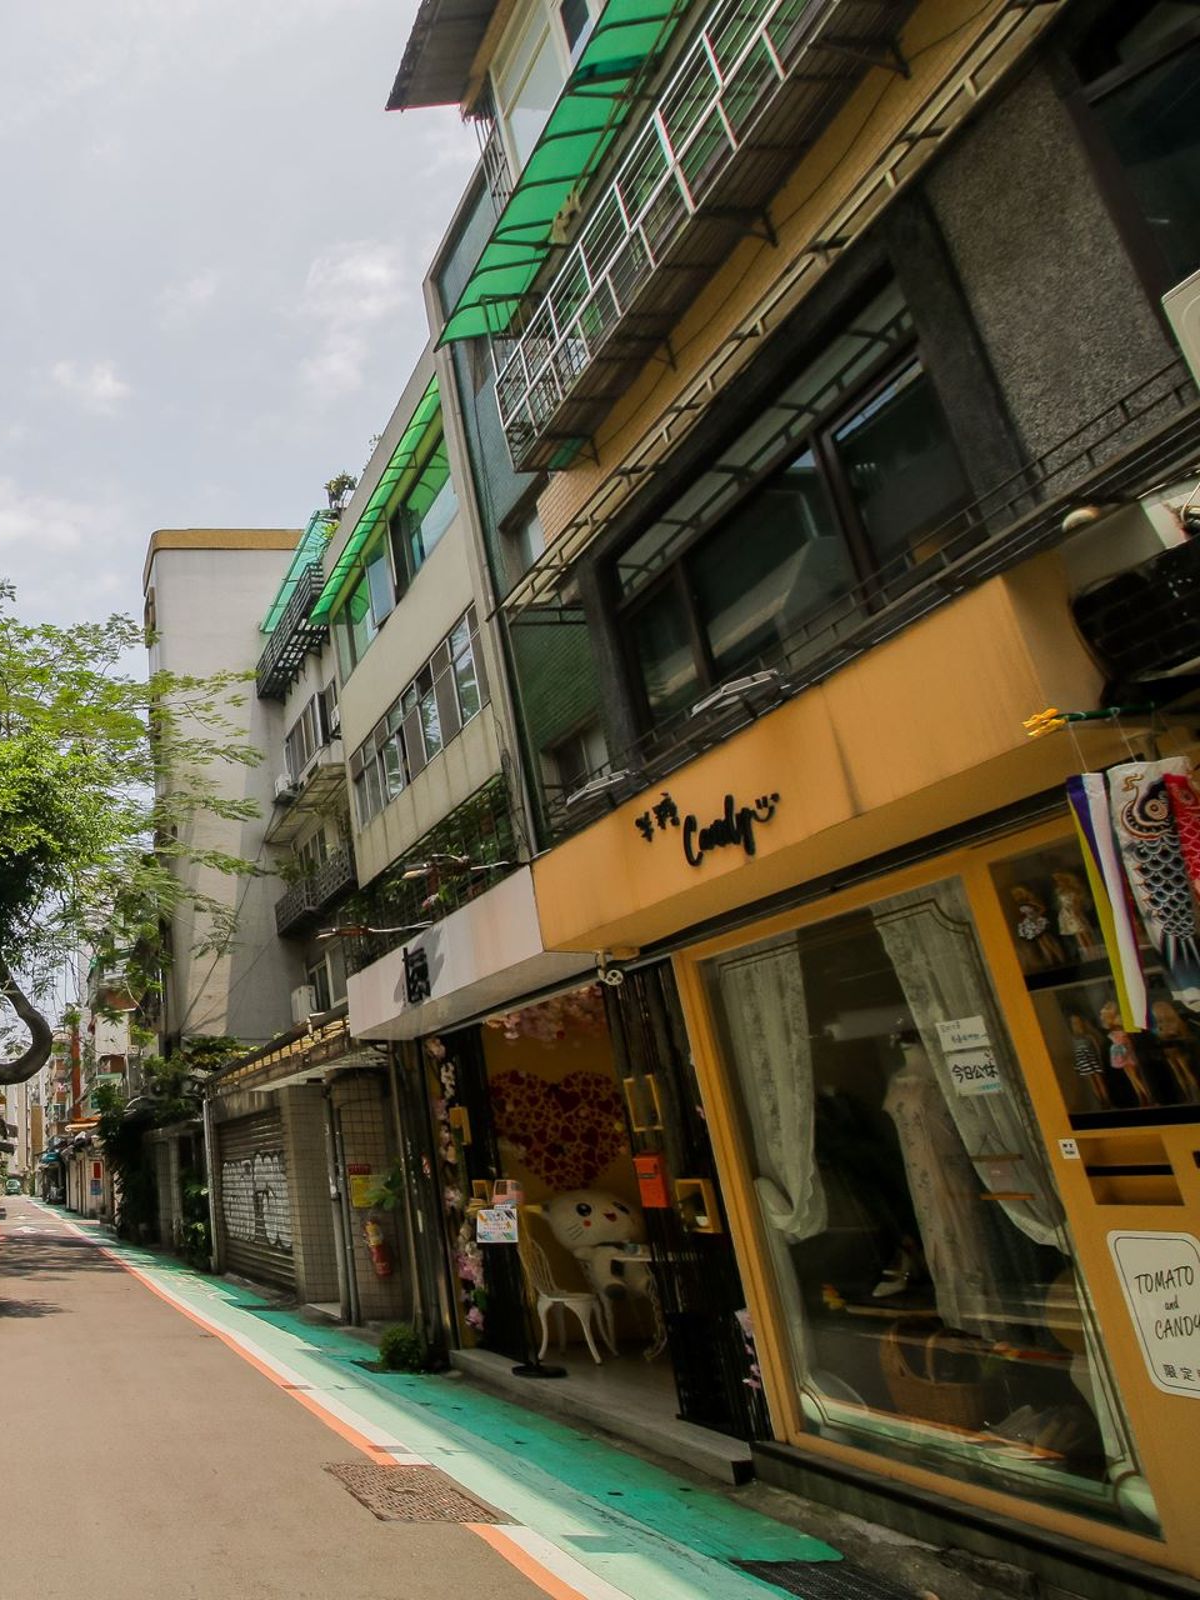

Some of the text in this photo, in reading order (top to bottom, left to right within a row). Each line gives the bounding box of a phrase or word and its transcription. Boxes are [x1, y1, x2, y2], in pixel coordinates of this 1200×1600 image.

[683, 794, 756, 868] Candy
[952, 1062, 999, 1083] 今日公休
[1135, 1265, 1194, 1294] TOMATO
[1165, 1295, 1179, 1310] and
[1163, 1364, 1200, 1381] 限定
